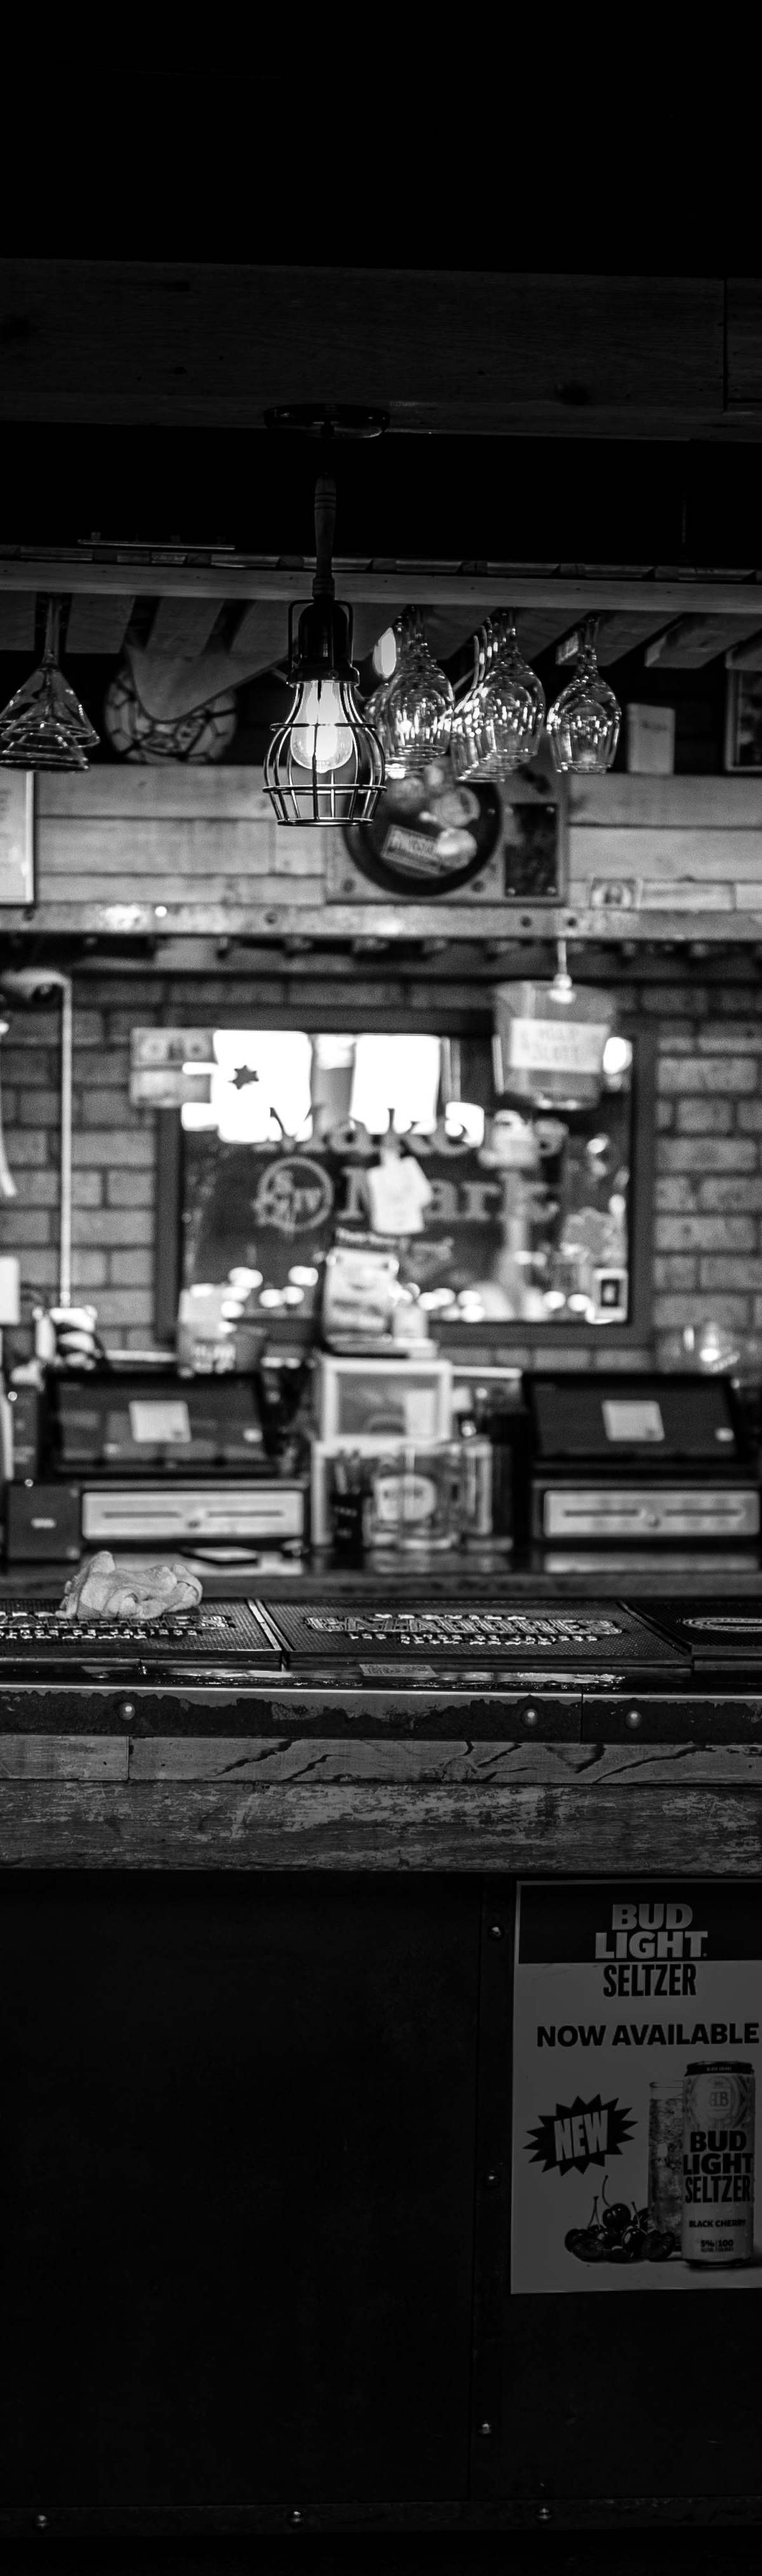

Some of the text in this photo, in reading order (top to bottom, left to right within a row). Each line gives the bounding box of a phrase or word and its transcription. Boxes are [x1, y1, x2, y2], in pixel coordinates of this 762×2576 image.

[254, 1106, 569, 1157] Makes
[612, 1902, 693, 1930] BUD
[595, 1930, 709, 1959] LIGHT
[603, 1963, 697, 1997] SELTZER
[537, 2022, 760, 2047] NOW AVAILABLE
[554, 2109, 610, 2161] NEW
[690, 2130, 747, 2153] BUD
[683, 2153, 754, 2175] LIGHT
[685, 2175, 751, 2203] SELTZER
